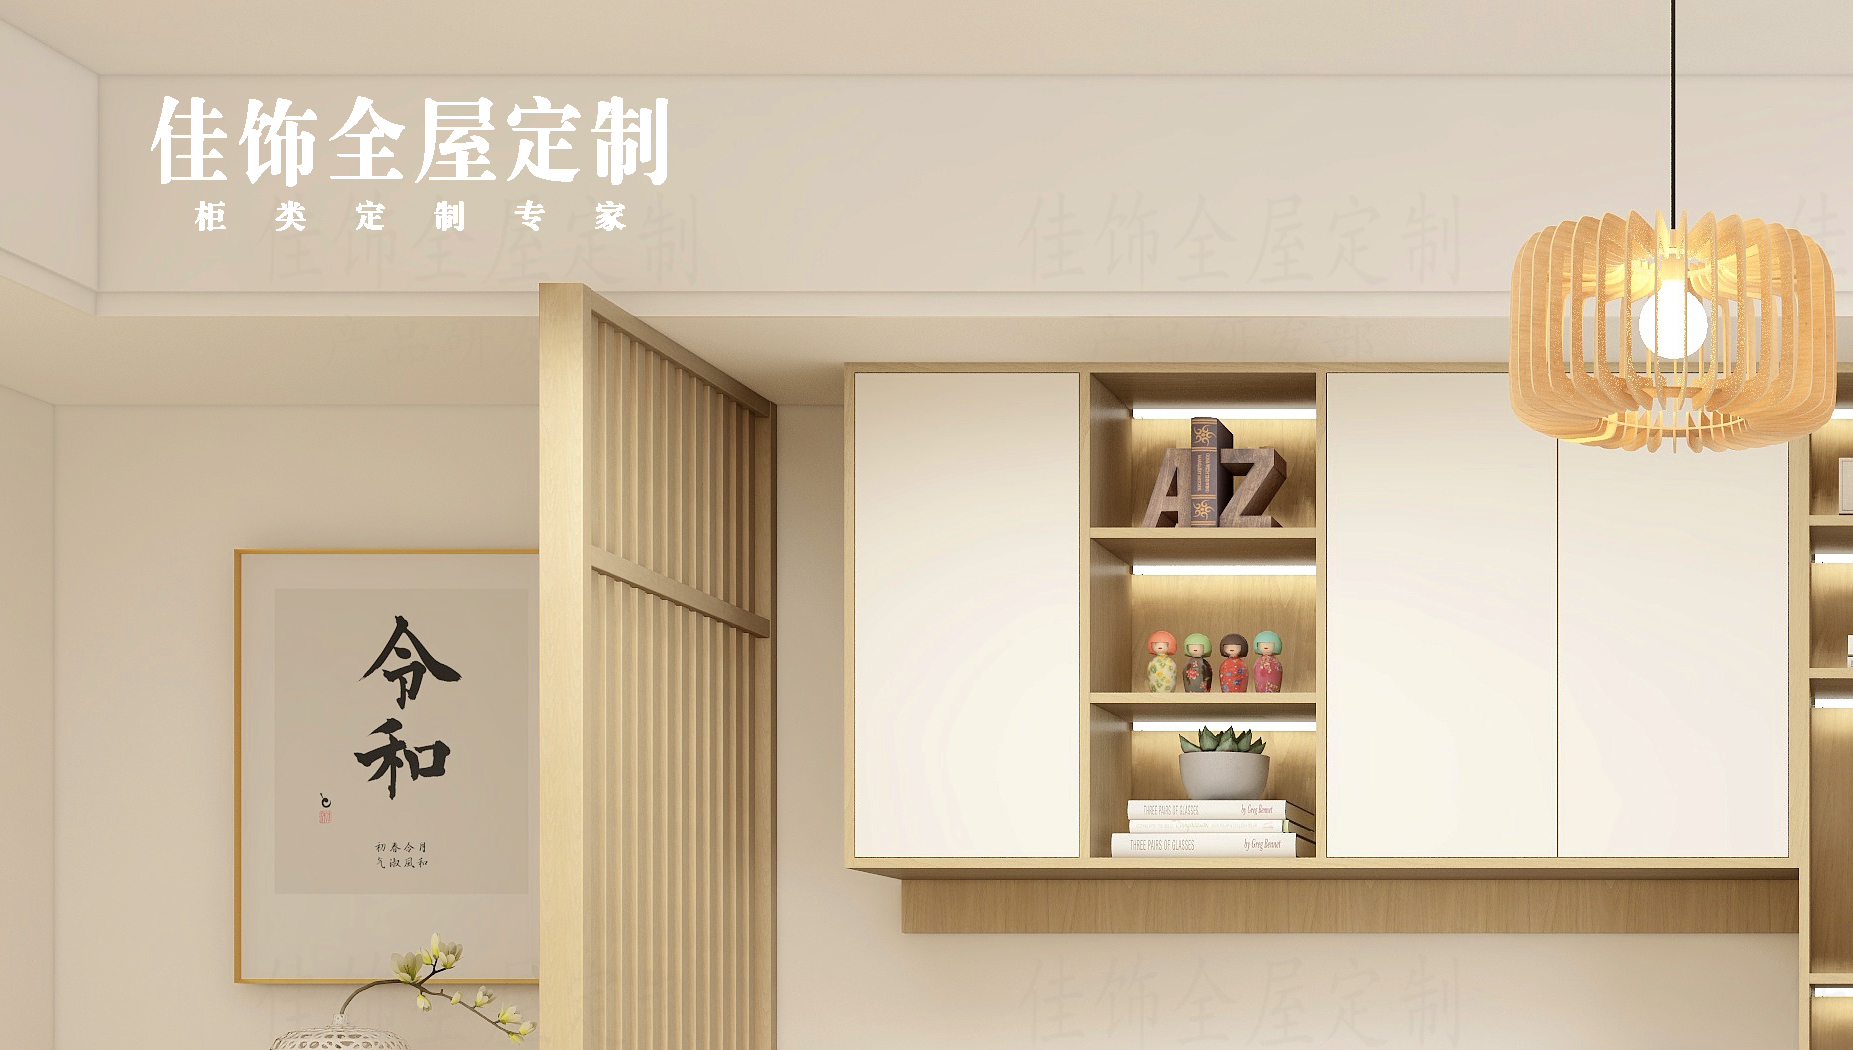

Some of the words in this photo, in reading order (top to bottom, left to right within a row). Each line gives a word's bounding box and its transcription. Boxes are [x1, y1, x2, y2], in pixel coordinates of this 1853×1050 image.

[353, 615, 462, 800] 令和
[1143, 805, 1158, 816] THREE
[1179, 805, 1199, 816] GLASSES
[1241, 804, 1247, 814] by
[1130, 839, 1147, 851] THREE
[1147, 839, 1162, 851] PAIRS
[1163, 839, 1171, 851] OF
[1171, 839, 1195, 851] GLASSES
[1244, 839, 1250, 851] by
[1251, 839, 1264, 851] Greg
